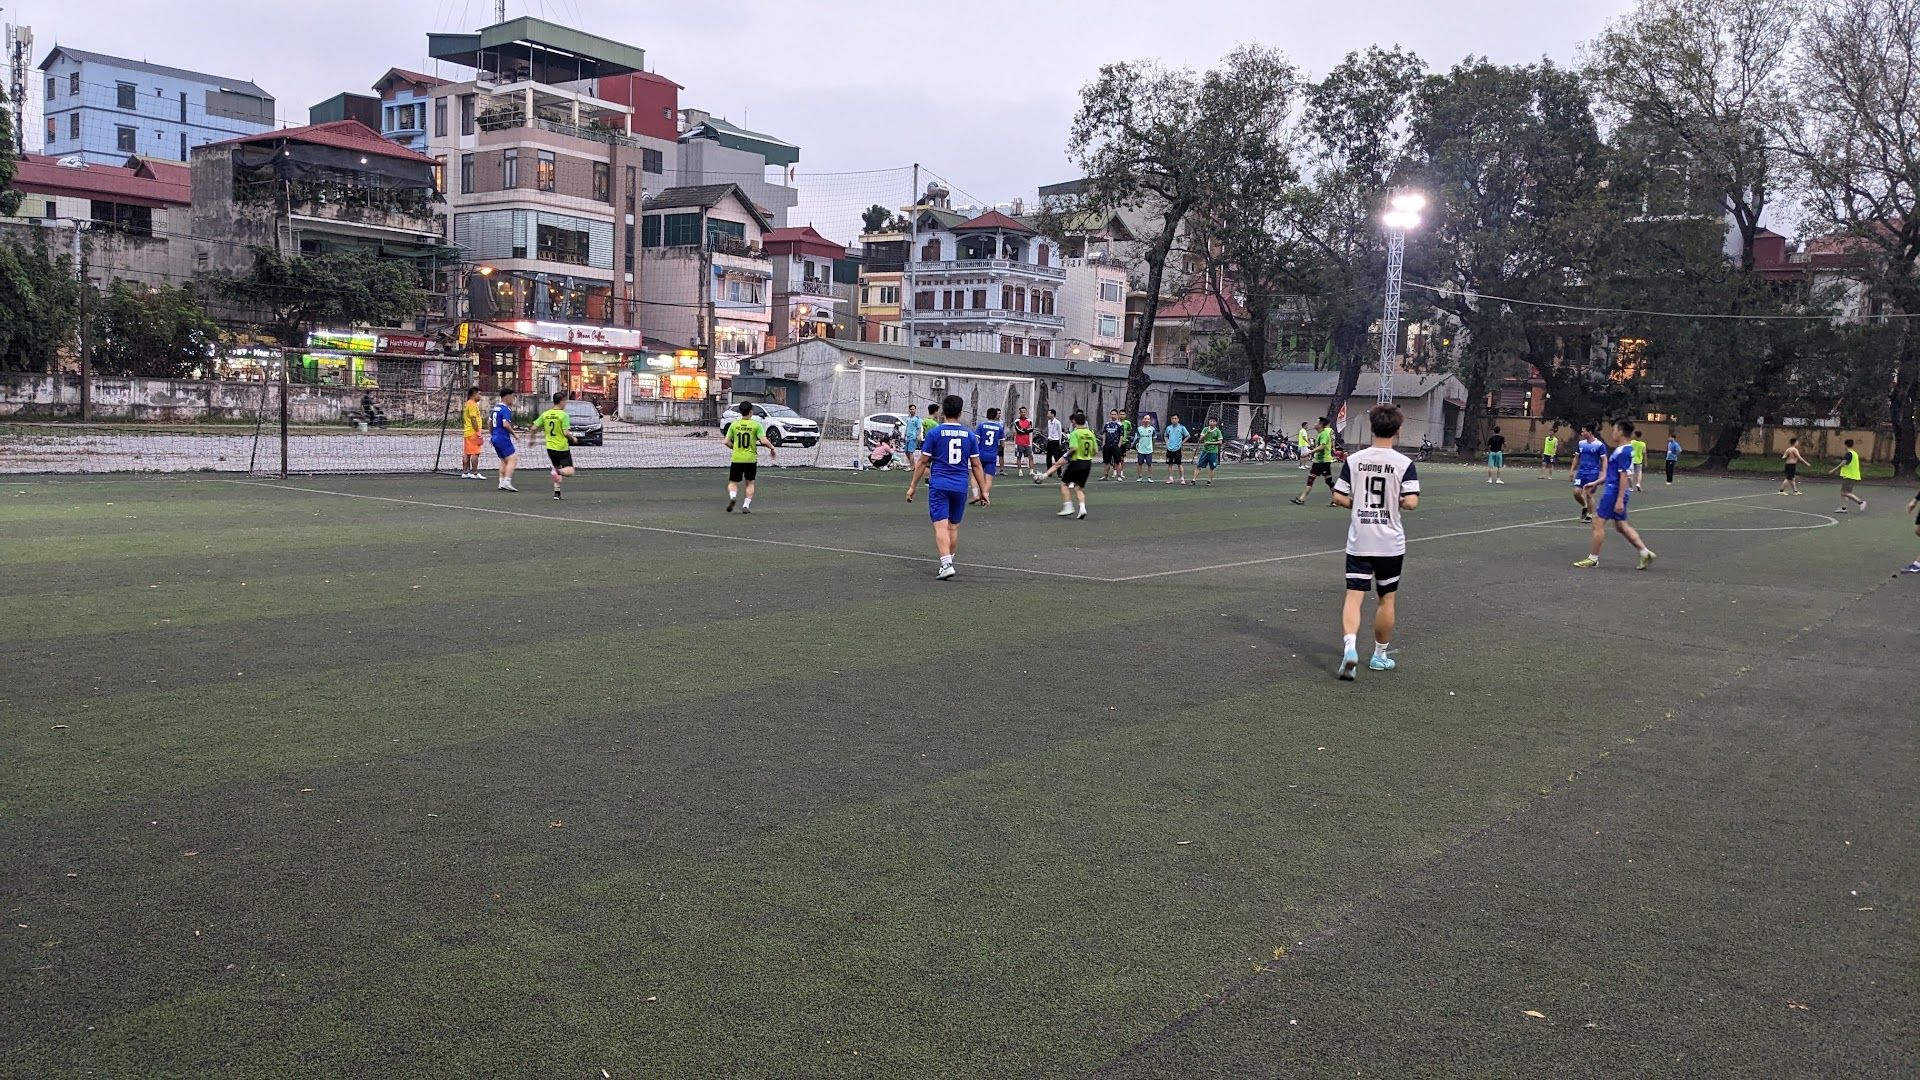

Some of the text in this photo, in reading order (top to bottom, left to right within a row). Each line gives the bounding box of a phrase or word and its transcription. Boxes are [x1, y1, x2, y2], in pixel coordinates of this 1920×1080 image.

[548, 420, 557, 437] 2
[736, 431, 751, 449] 10
[984, 430, 995, 446] 3
[948, 438, 962, 465] 6
[1083, 441, 1091, 457] 8
[1365, 475, 1386, 509] 19
[1357, 508, 1379, 518] Camera
